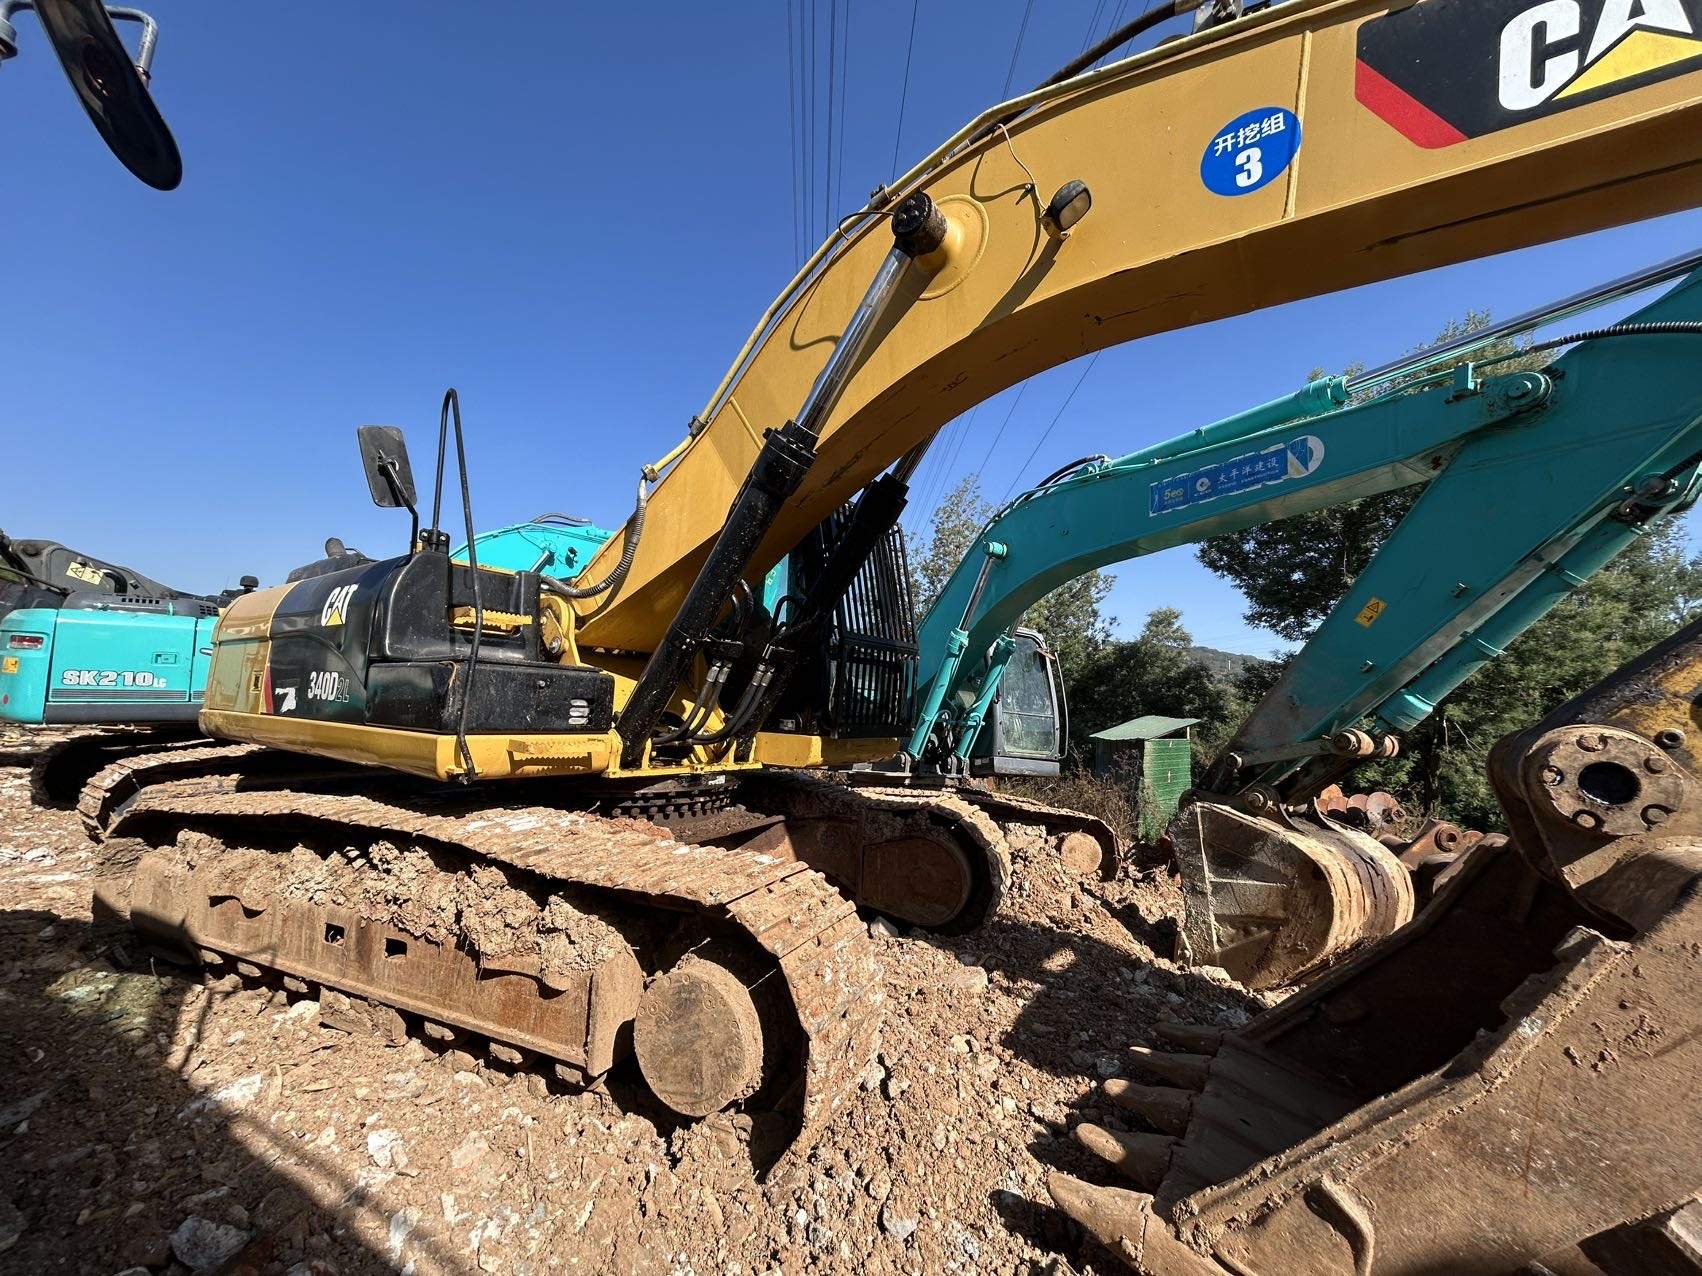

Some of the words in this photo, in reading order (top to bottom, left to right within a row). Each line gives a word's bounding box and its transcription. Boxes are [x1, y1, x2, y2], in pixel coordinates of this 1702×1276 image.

[1213, 112, 1286, 157] 开挖组
[1235, 147, 1263, 188] 3
[321, 583, 359, 627] CAT
